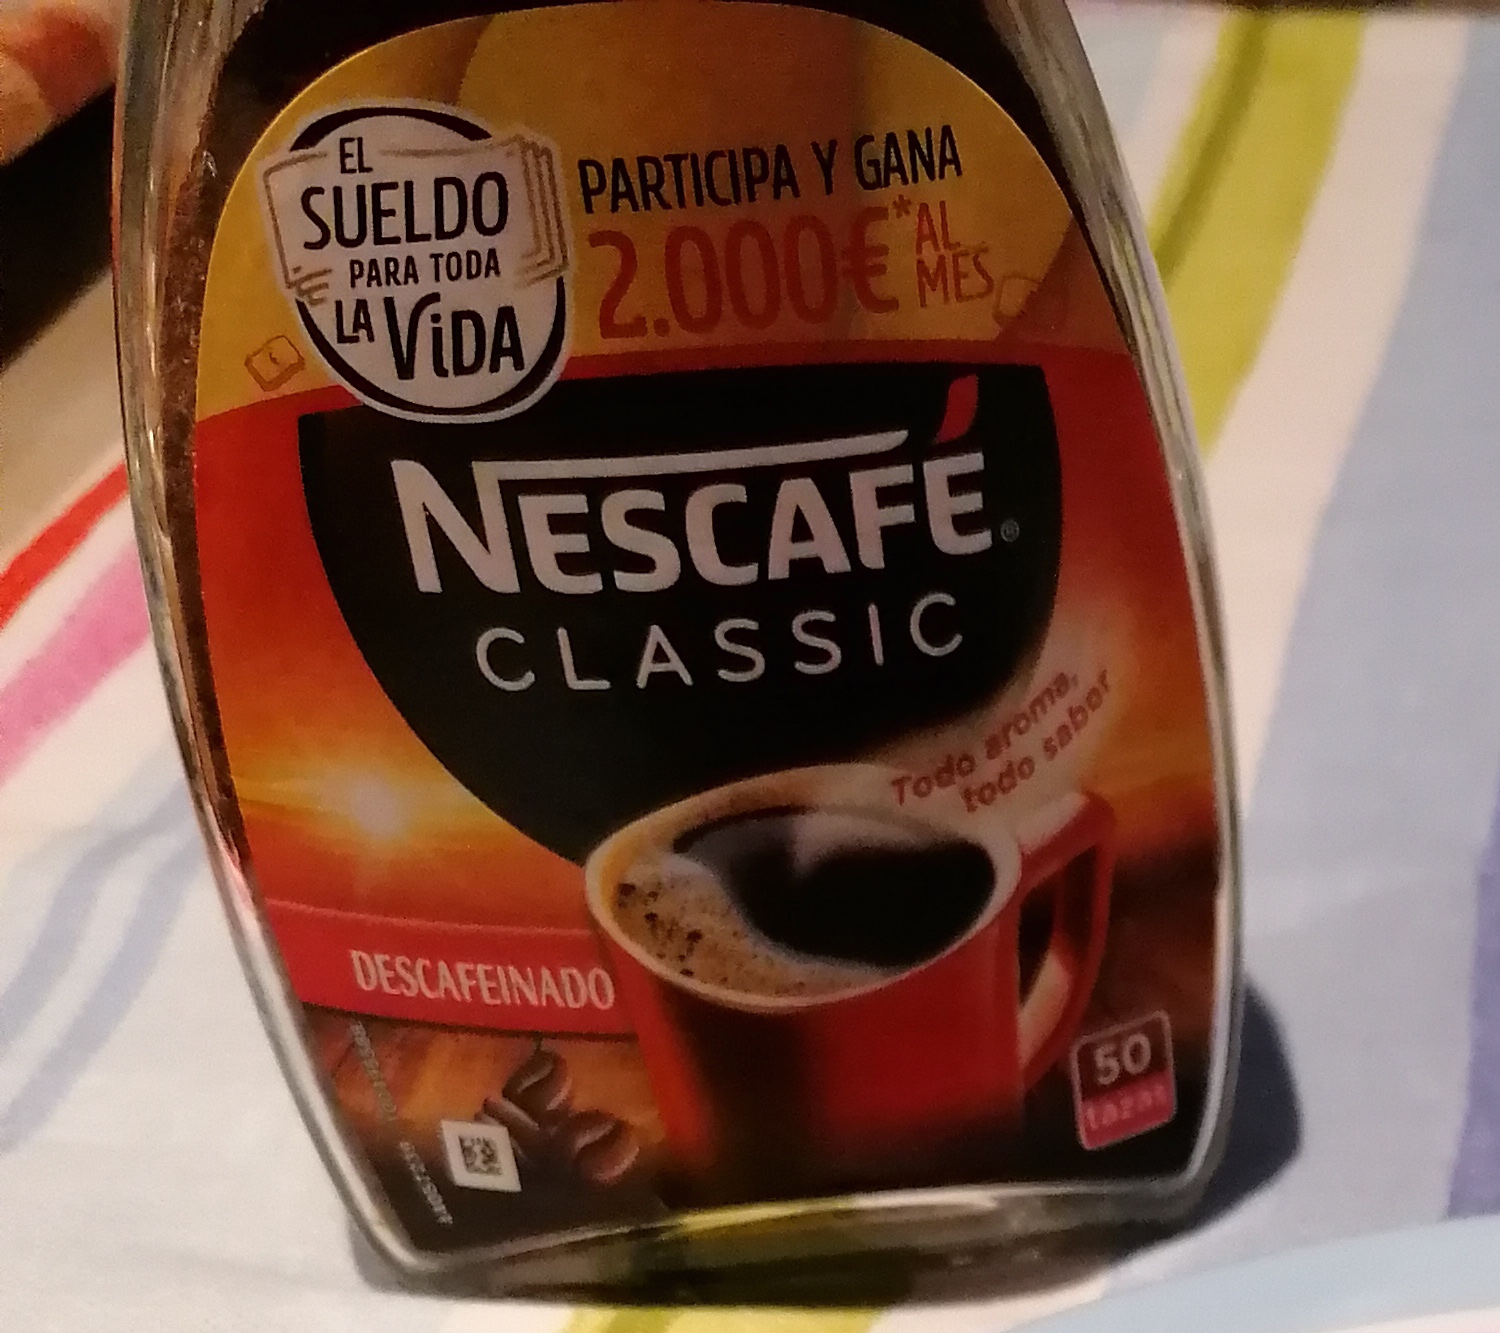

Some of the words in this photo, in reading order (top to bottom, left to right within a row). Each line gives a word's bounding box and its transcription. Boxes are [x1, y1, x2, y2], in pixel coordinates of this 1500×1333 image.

[339, 137, 373, 174] EL
[577, 143, 800, 214] PARTICIPA
[810, 139, 838, 195] Y
[854, 125, 963, 190] GANA
[300, 171, 509, 251] SUELDO
[916, 200, 961, 255] AL
[349, 255, 419, 288] PARA
[430, 248, 501, 282] TODA
[915, 240, 995, 308] MES
[334, 299, 375, 344] LA
[475, 592, 964, 692] CLASSIC
[961, 755, 1036, 813] todo
[1043, 669, 1110, 762] sabor
[891, 754, 977, 806] Todo
[350, 949, 616, 1010] DESCAFEINADO
[1093, 1033, 1152, 1085] 50
